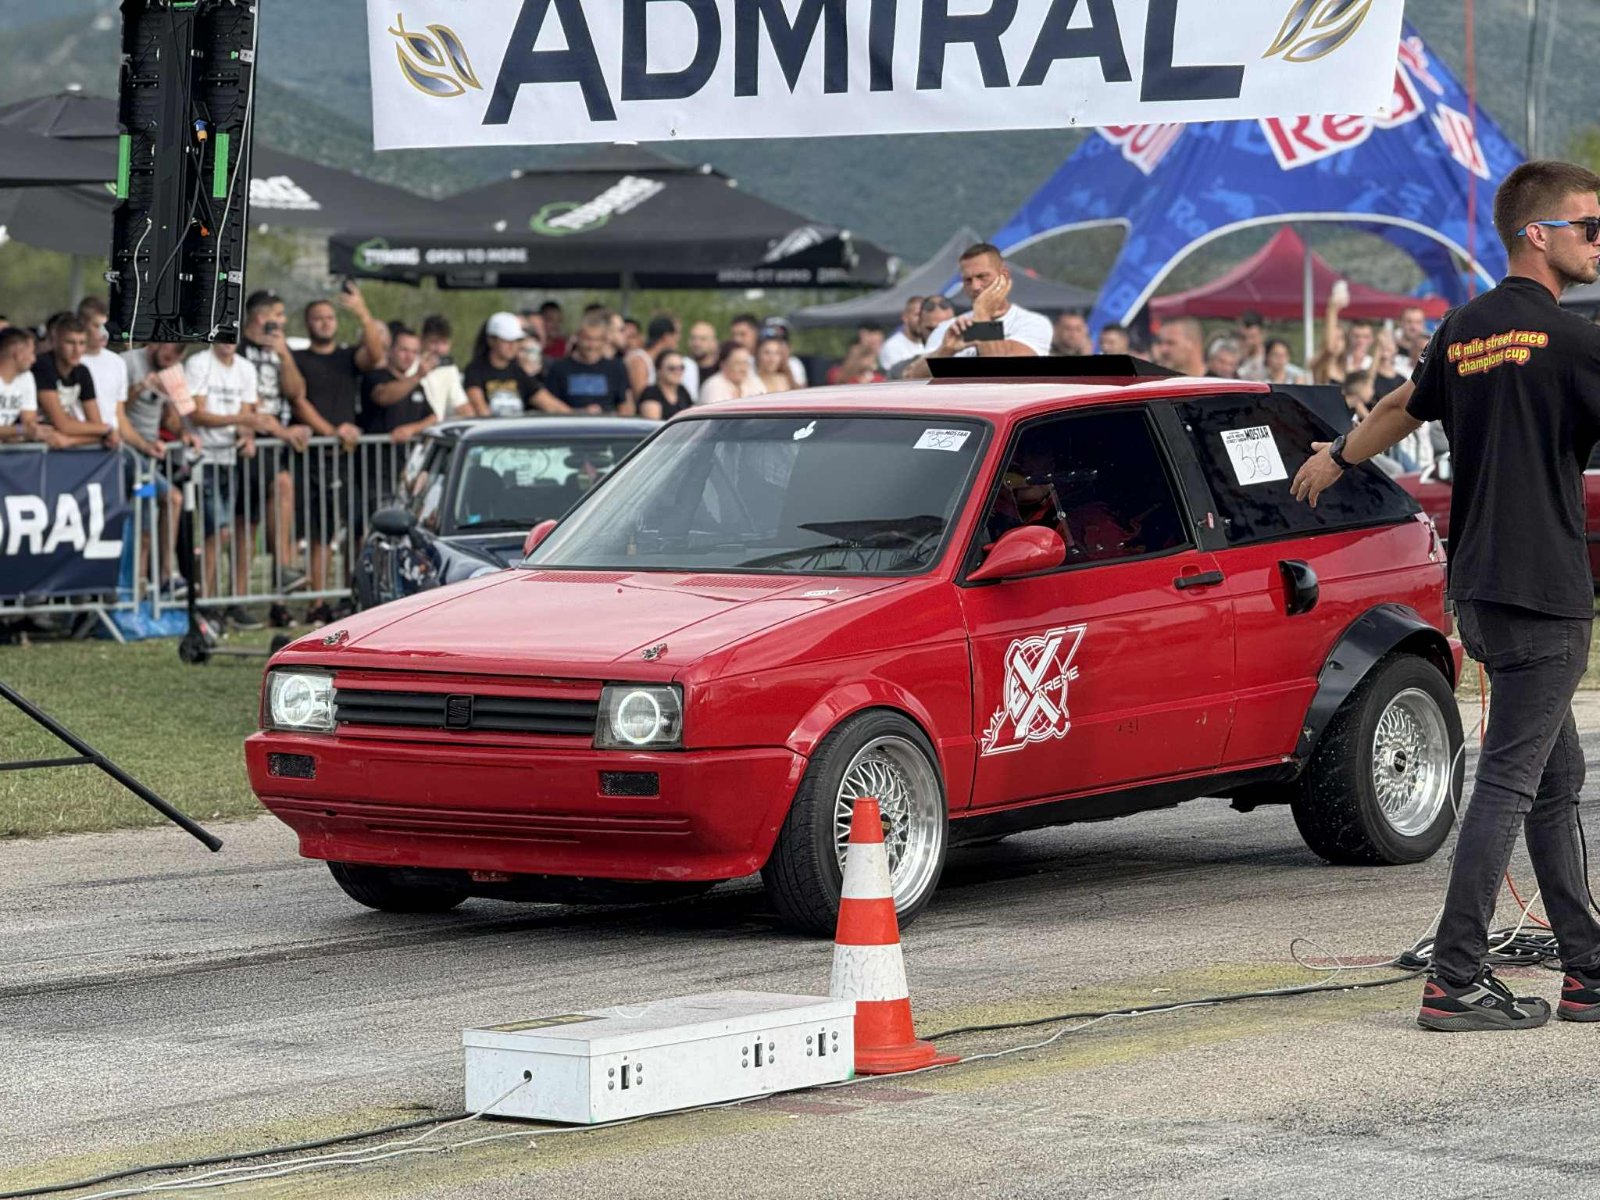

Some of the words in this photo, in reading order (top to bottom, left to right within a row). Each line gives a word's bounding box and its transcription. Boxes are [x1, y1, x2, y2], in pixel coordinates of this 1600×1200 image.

[481, 0, 1245, 125] ADMIRAL
[1448, 344, 1461, 360] 1/4
[1463, 340, 1484, 355] mile
[1486, 332, 1513, 349] street
[1515, 332, 1546, 345] race
[1459, 350, 1504, 373] champions
[1505, 348, 1528, 362] cup
[1244, 427, 1270, 440] MOSTAR
[0, 483, 123, 559] RAL
